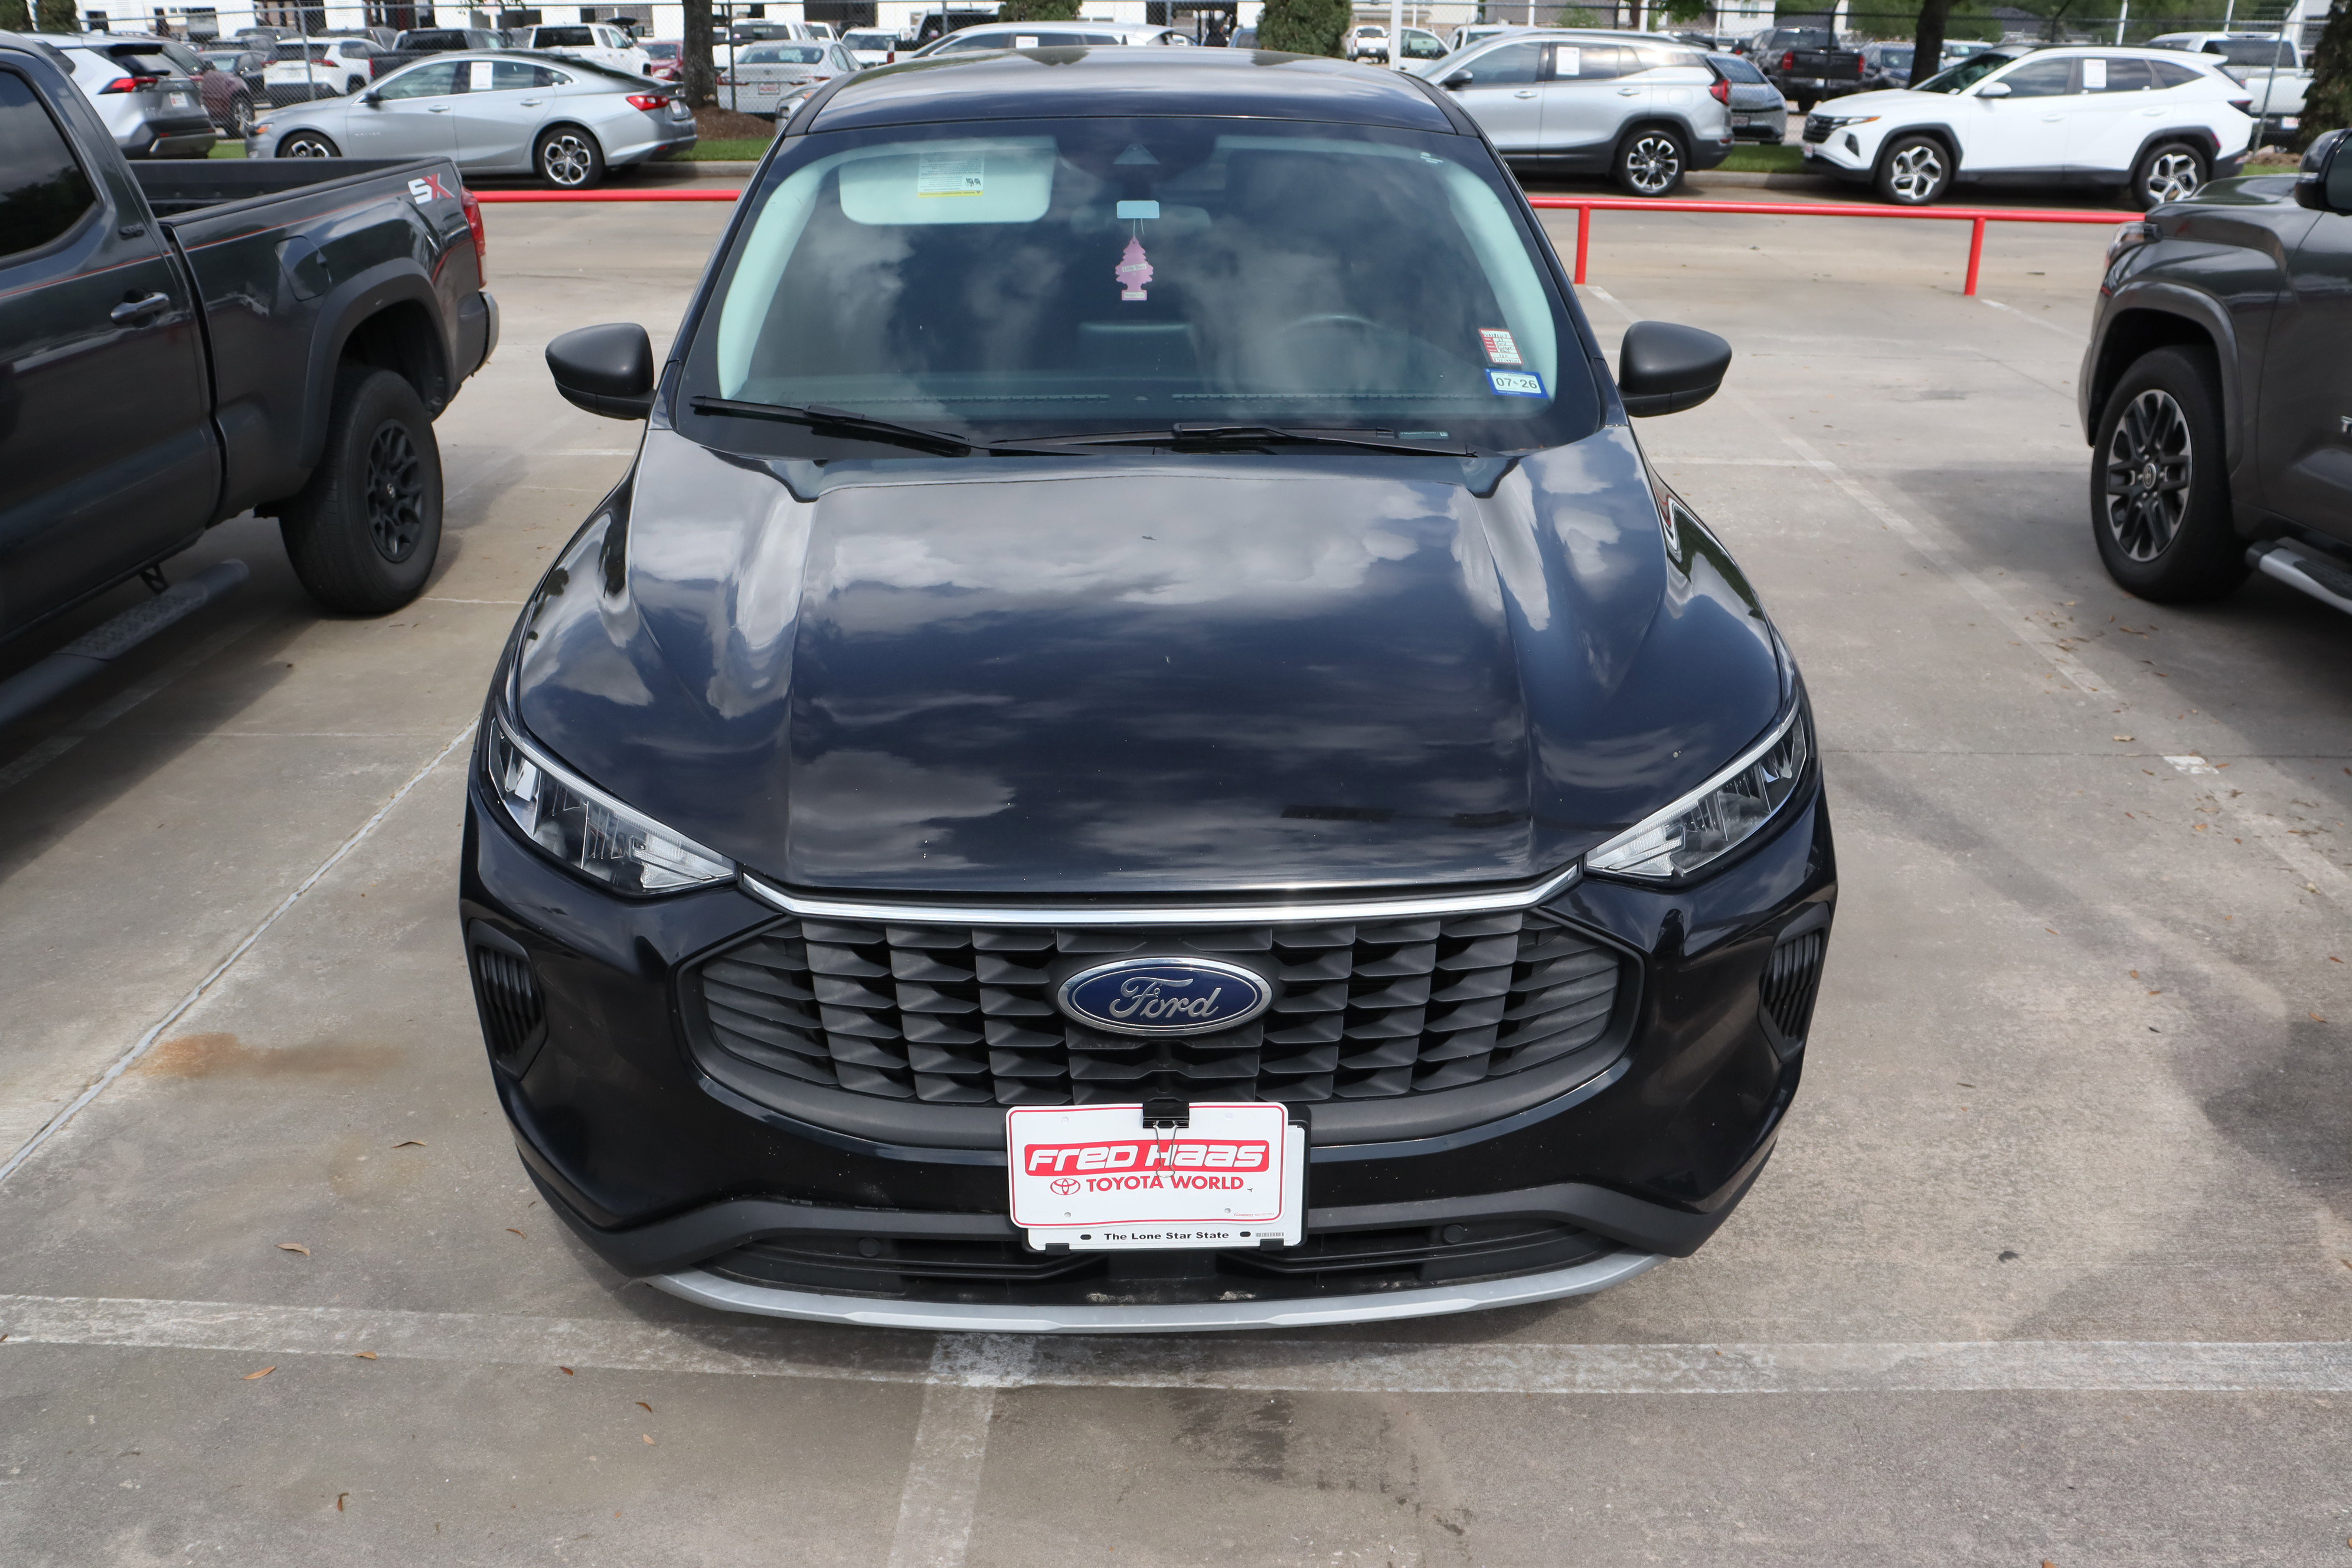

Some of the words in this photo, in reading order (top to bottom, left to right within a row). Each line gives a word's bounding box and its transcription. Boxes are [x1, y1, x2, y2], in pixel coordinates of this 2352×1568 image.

[408, 173, 455, 204] SX
[1109, 976, 1221, 1018] Ford
[1086, 1175, 1164, 1192] TOYOTA
[1171, 1175, 1244, 1190] WORLD
